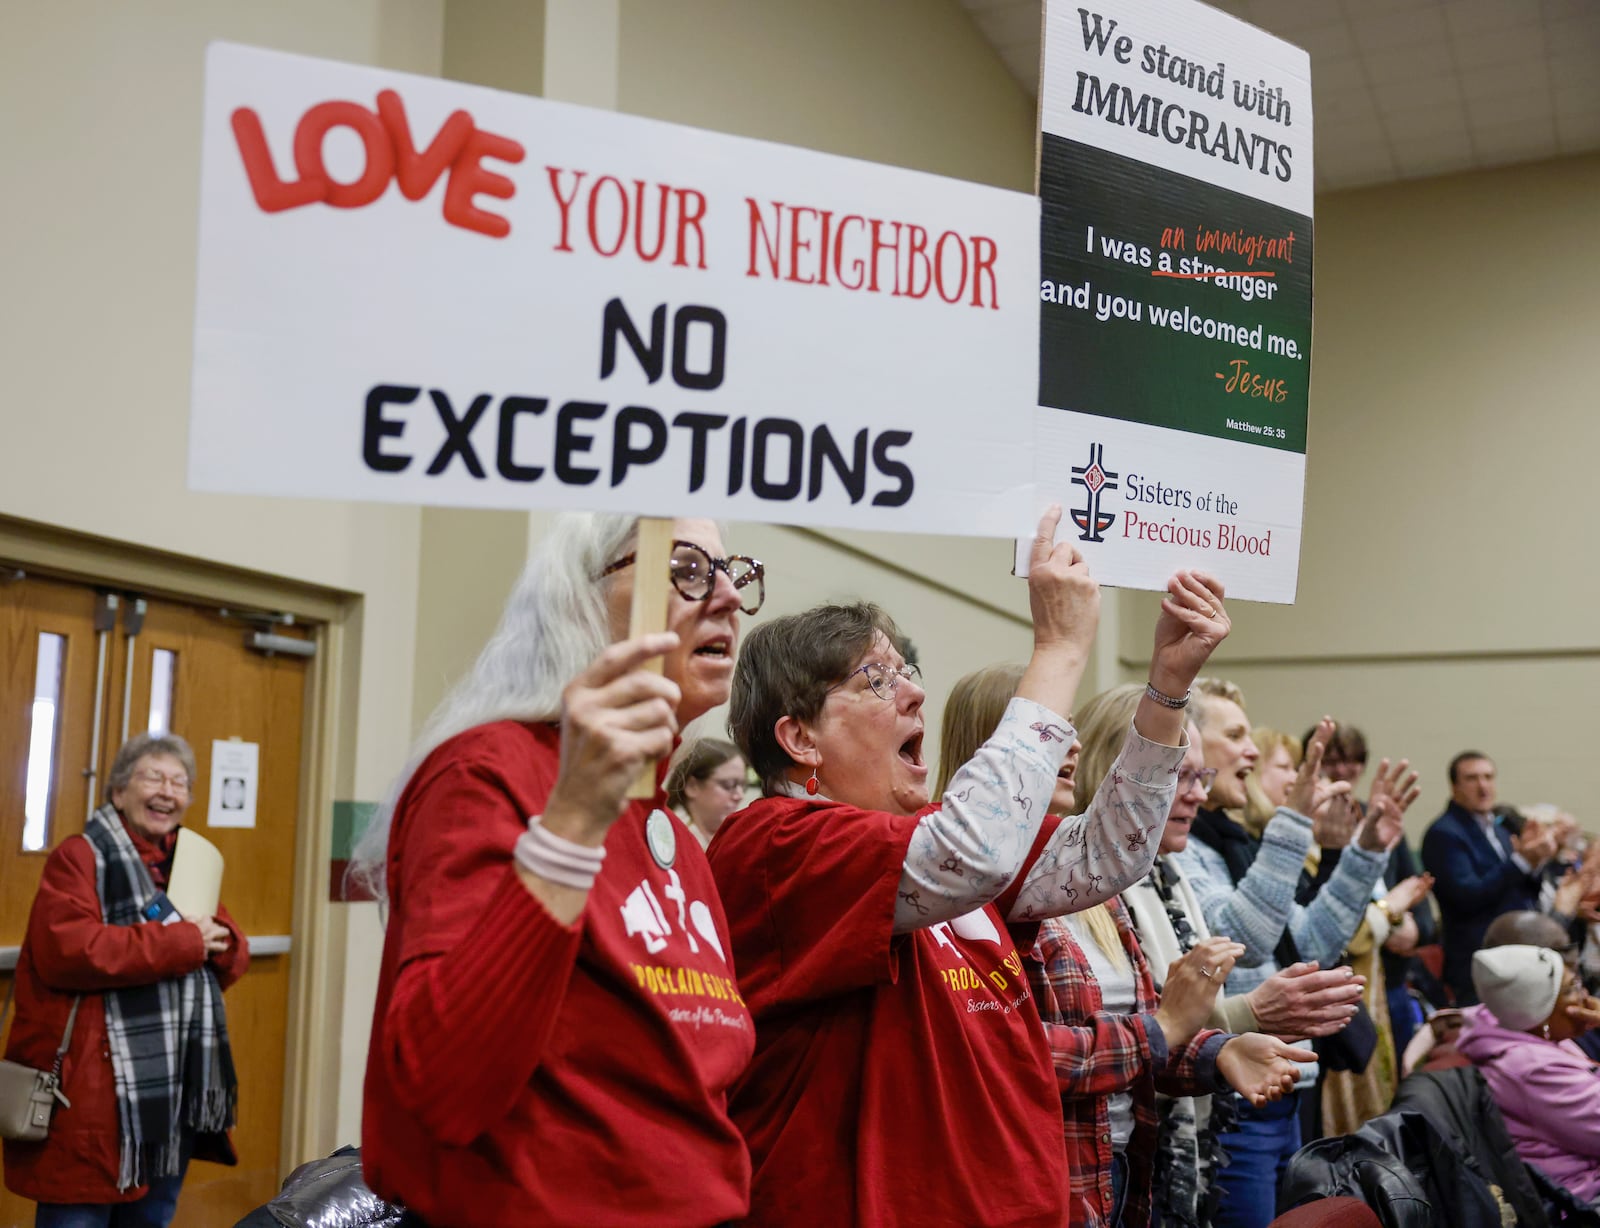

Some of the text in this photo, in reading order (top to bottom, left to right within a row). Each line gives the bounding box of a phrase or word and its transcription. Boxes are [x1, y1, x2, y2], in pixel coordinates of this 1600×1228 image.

[1077, 8, 1292, 126] We stand with
[1071, 71, 1293, 183] IMMIGRANTS
[230, 87, 1000, 310] LOVE YOUR NEIGHBOR
[1086, 226, 1278, 301] I was a stranger
[1160, 224, 1296, 265] an immigrant
[600, 296, 727, 391] NO
[1040, 279, 1303, 361] and you welcomed me.
[1215, 359, 1289, 403] -Jesus
[362, 383, 915, 508] EXCEPTIONS
[1226, 418, 1286, 439] Matthew 25: 35
[1125, 474, 1239, 516] Sisters of the
[1122, 511, 1271, 556] Precious Blood
[967, 999, 1000, 1013] Sisters
